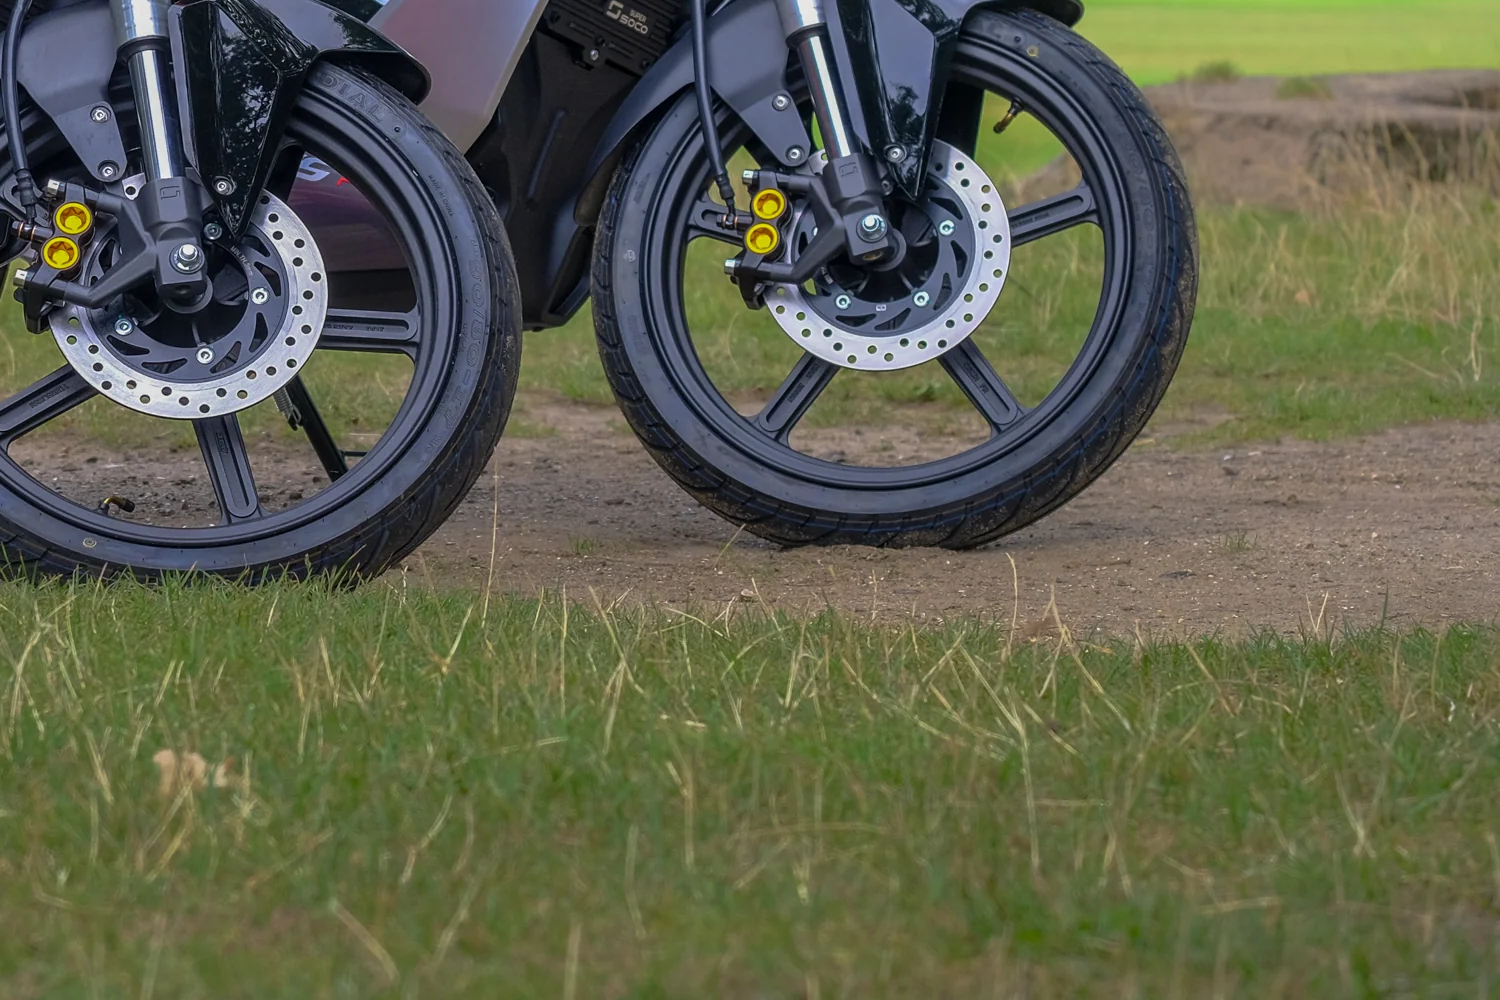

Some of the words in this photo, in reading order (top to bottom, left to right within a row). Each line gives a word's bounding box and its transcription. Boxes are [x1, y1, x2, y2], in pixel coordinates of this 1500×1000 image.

[619, 14, 649, 34] SOCO
[629, 9, 647, 23] SUPER
[320, 72, 382, 124] DIAL
